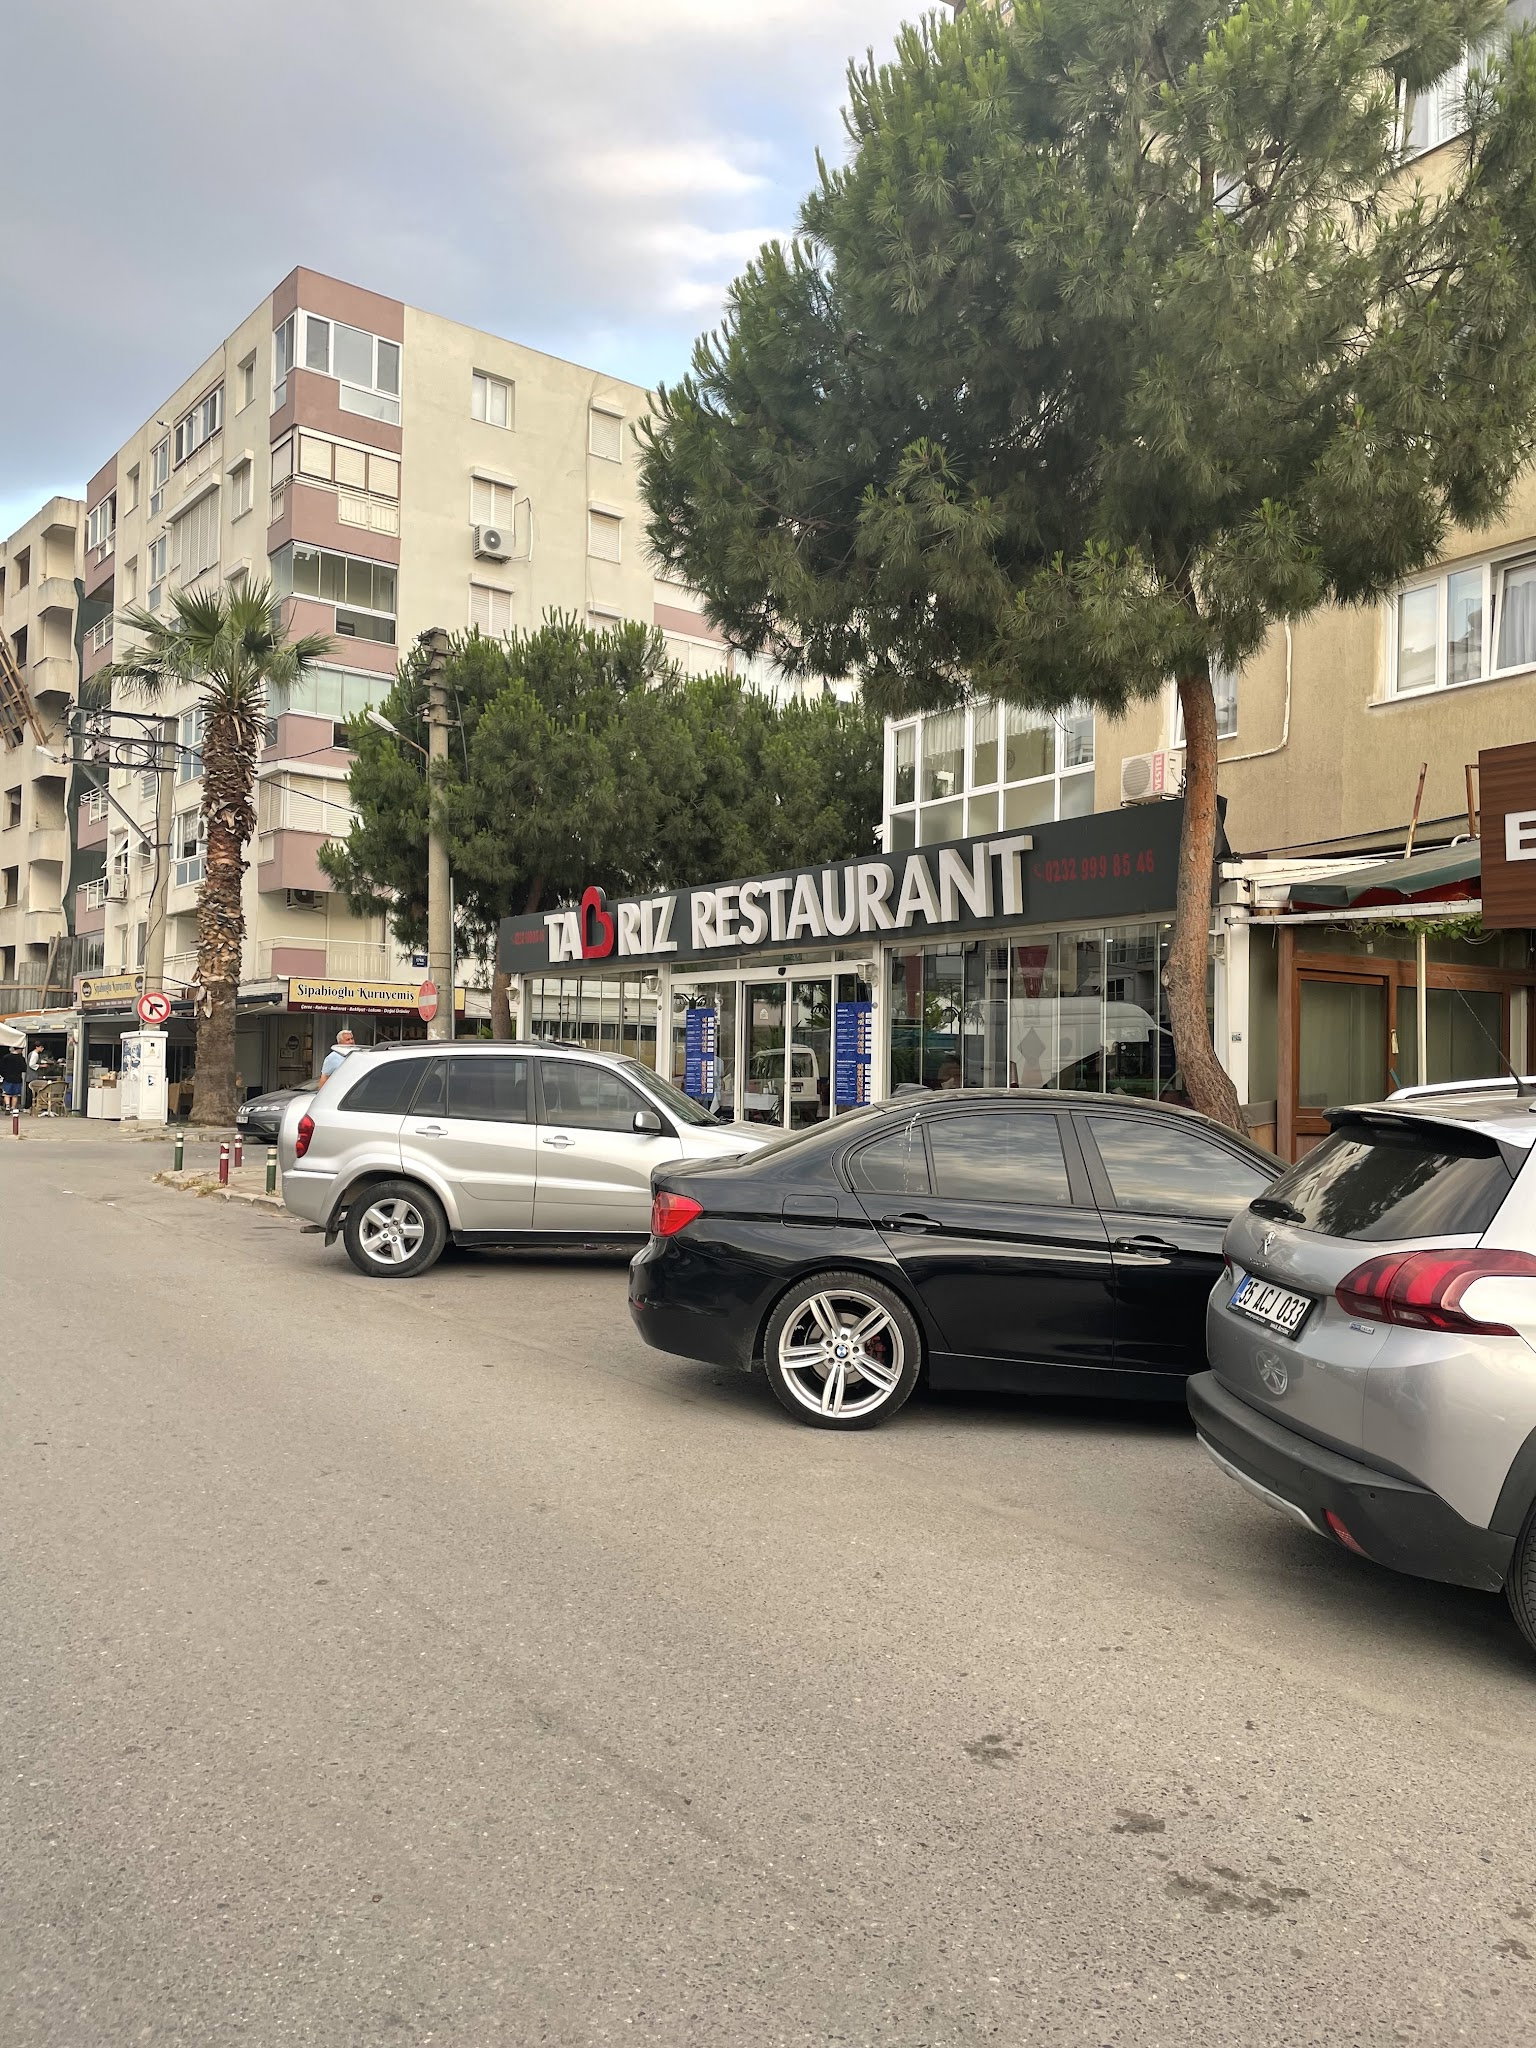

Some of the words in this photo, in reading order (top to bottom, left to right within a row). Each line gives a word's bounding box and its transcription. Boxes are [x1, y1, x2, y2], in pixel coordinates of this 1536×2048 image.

[1044, 857, 1076, 881] 0232
[1081, 855, 1107, 880] 999
[544, 886, 677, 963] TABRIZ
[691, 835, 1033, 949] RESTAURANT
[357, 987, 415, 1002] Kuruyemiş
[1238, 1281, 1260, 1305] 35
[1252, 1286, 1282, 1314] ACJ
[1276, 1296, 1306, 1326] 033
